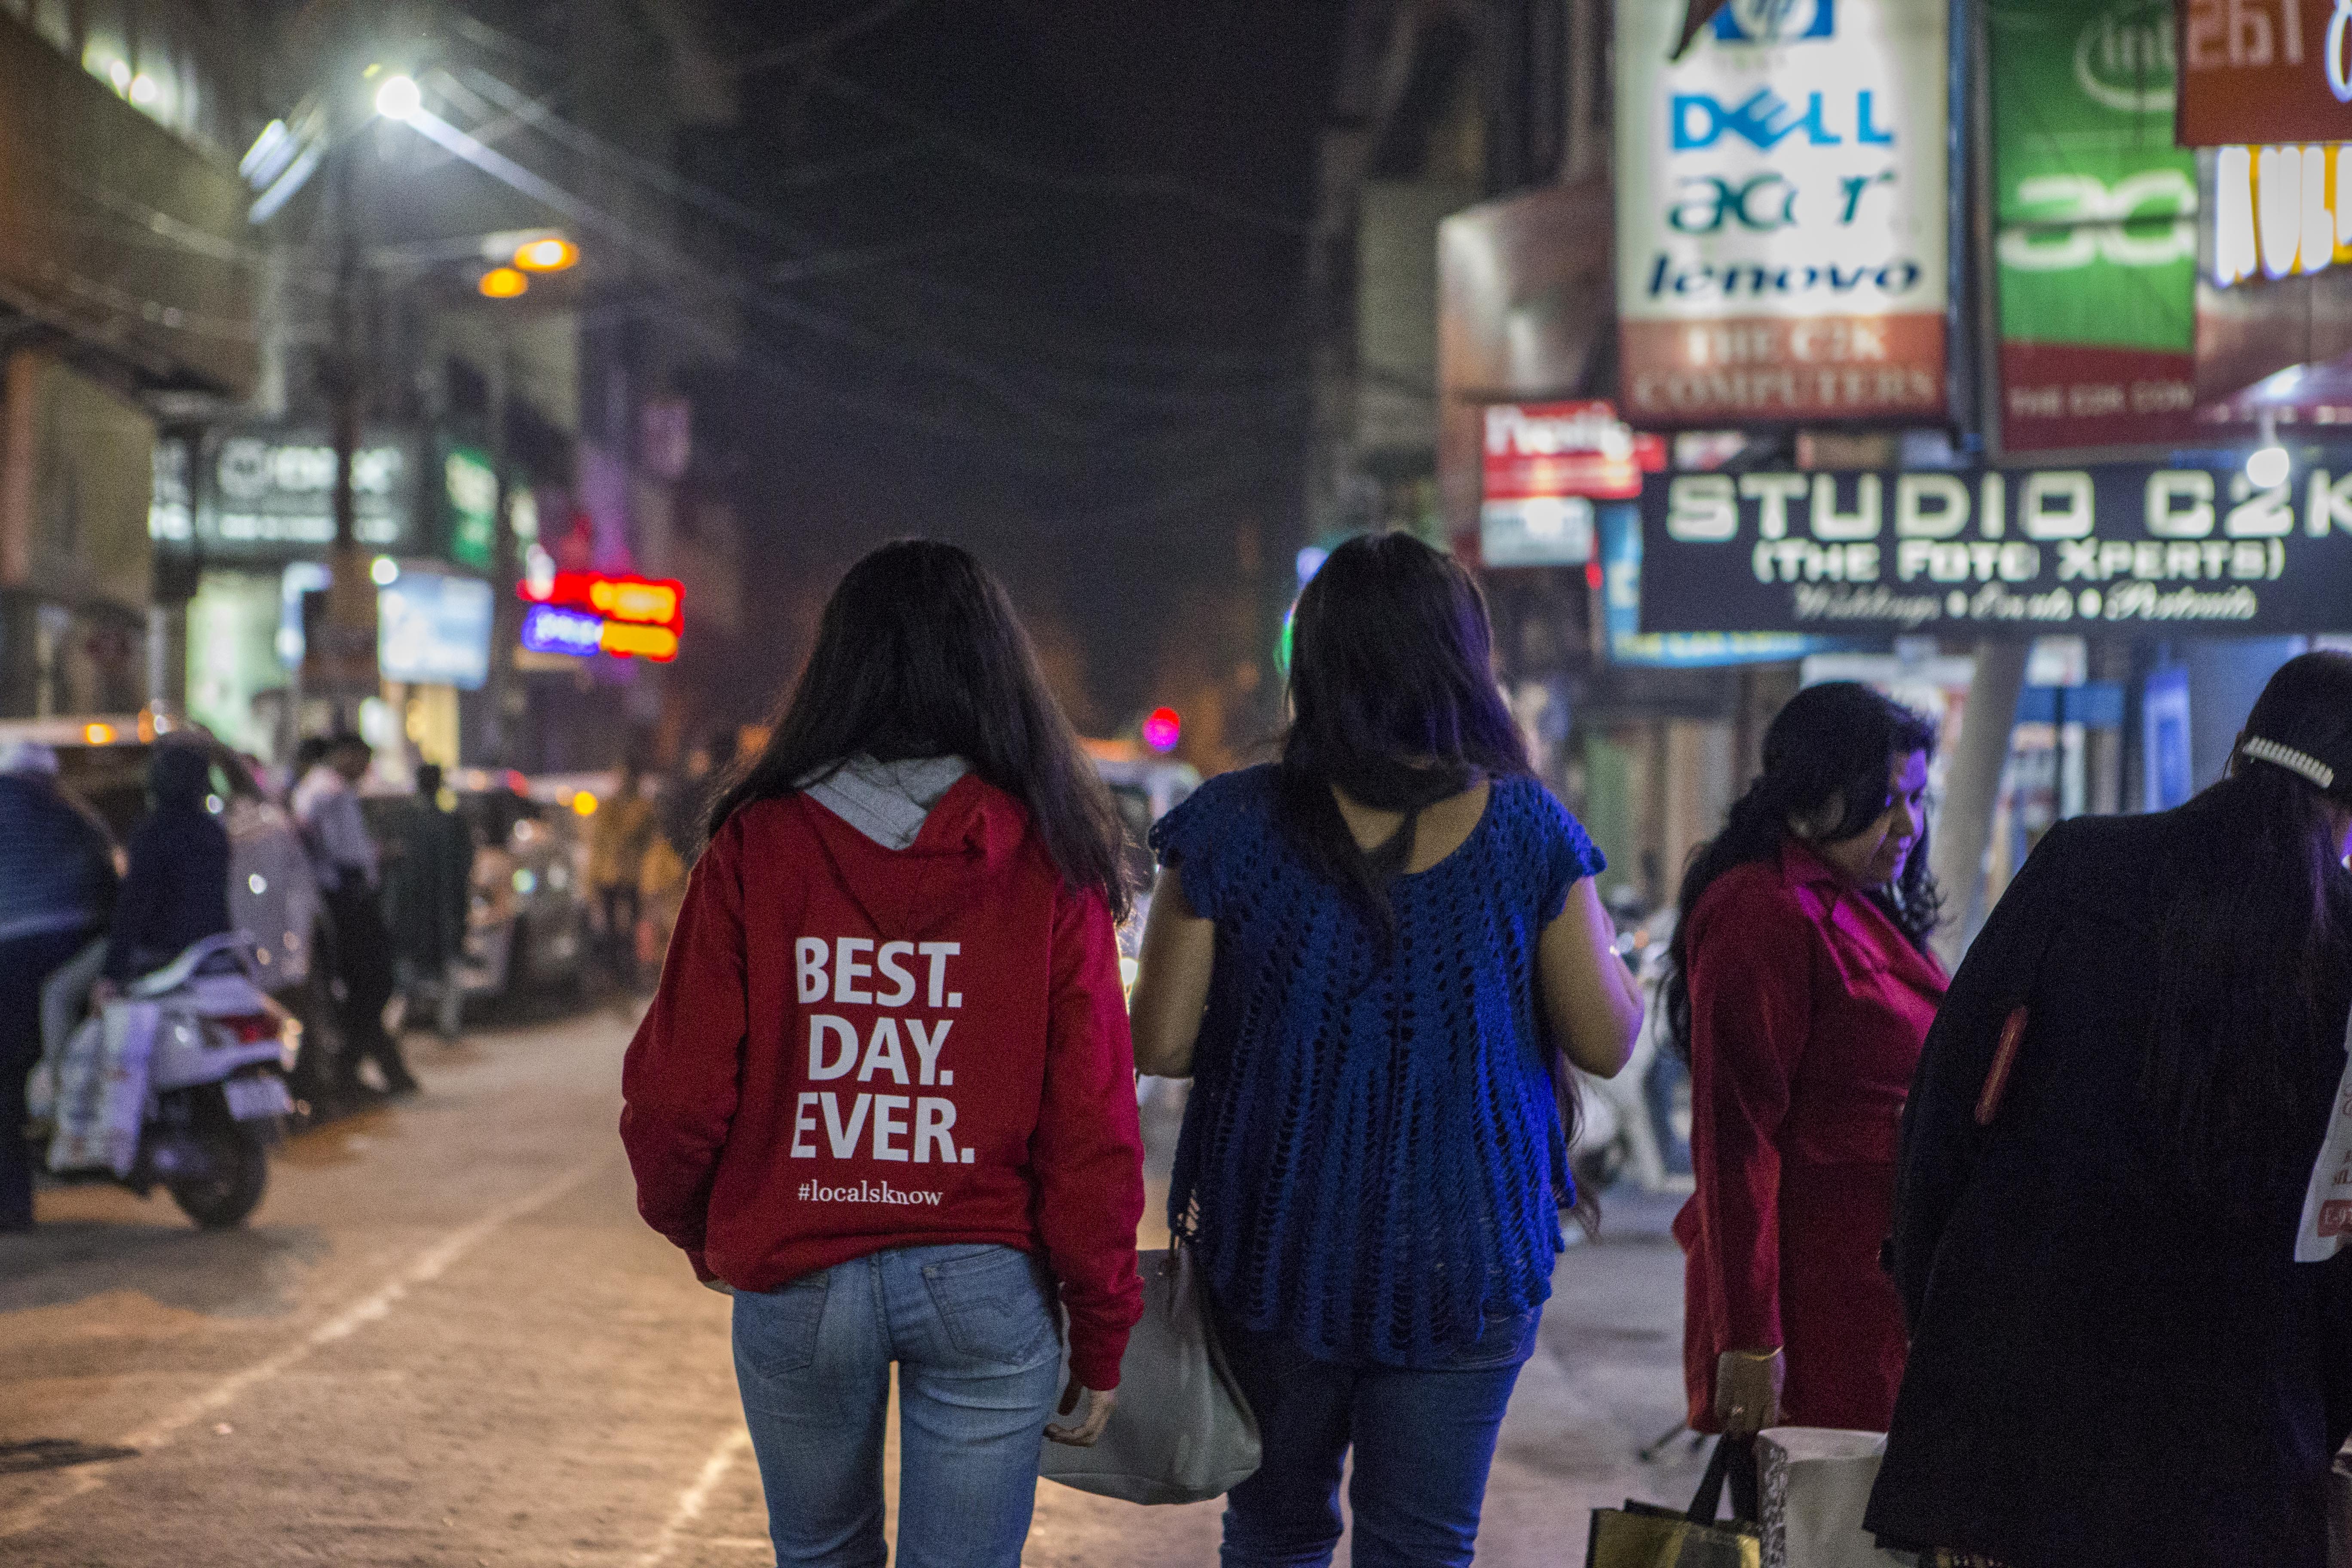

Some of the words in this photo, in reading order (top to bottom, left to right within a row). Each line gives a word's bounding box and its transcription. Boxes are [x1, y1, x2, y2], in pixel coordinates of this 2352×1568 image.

[1670, 86, 1895, 153] DELL
[1647, 254, 1922, 301] lenovo
[1631, 368, 1938, 412] COMPUTERS
[1668, 471, 2095, 541] STUDIO
[2144, 468, 2352, 538] C2K
[1752, 539, 1882, 583] (THE
[1896, 538, 2041, 582] FOTO
[795, 936, 963, 1008] BEST.
[808, 1014, 954, 1086] DAY.
[791, 1092, 975, 1164] EVER.
[798, 1179, 943, 1206] #localsknow
